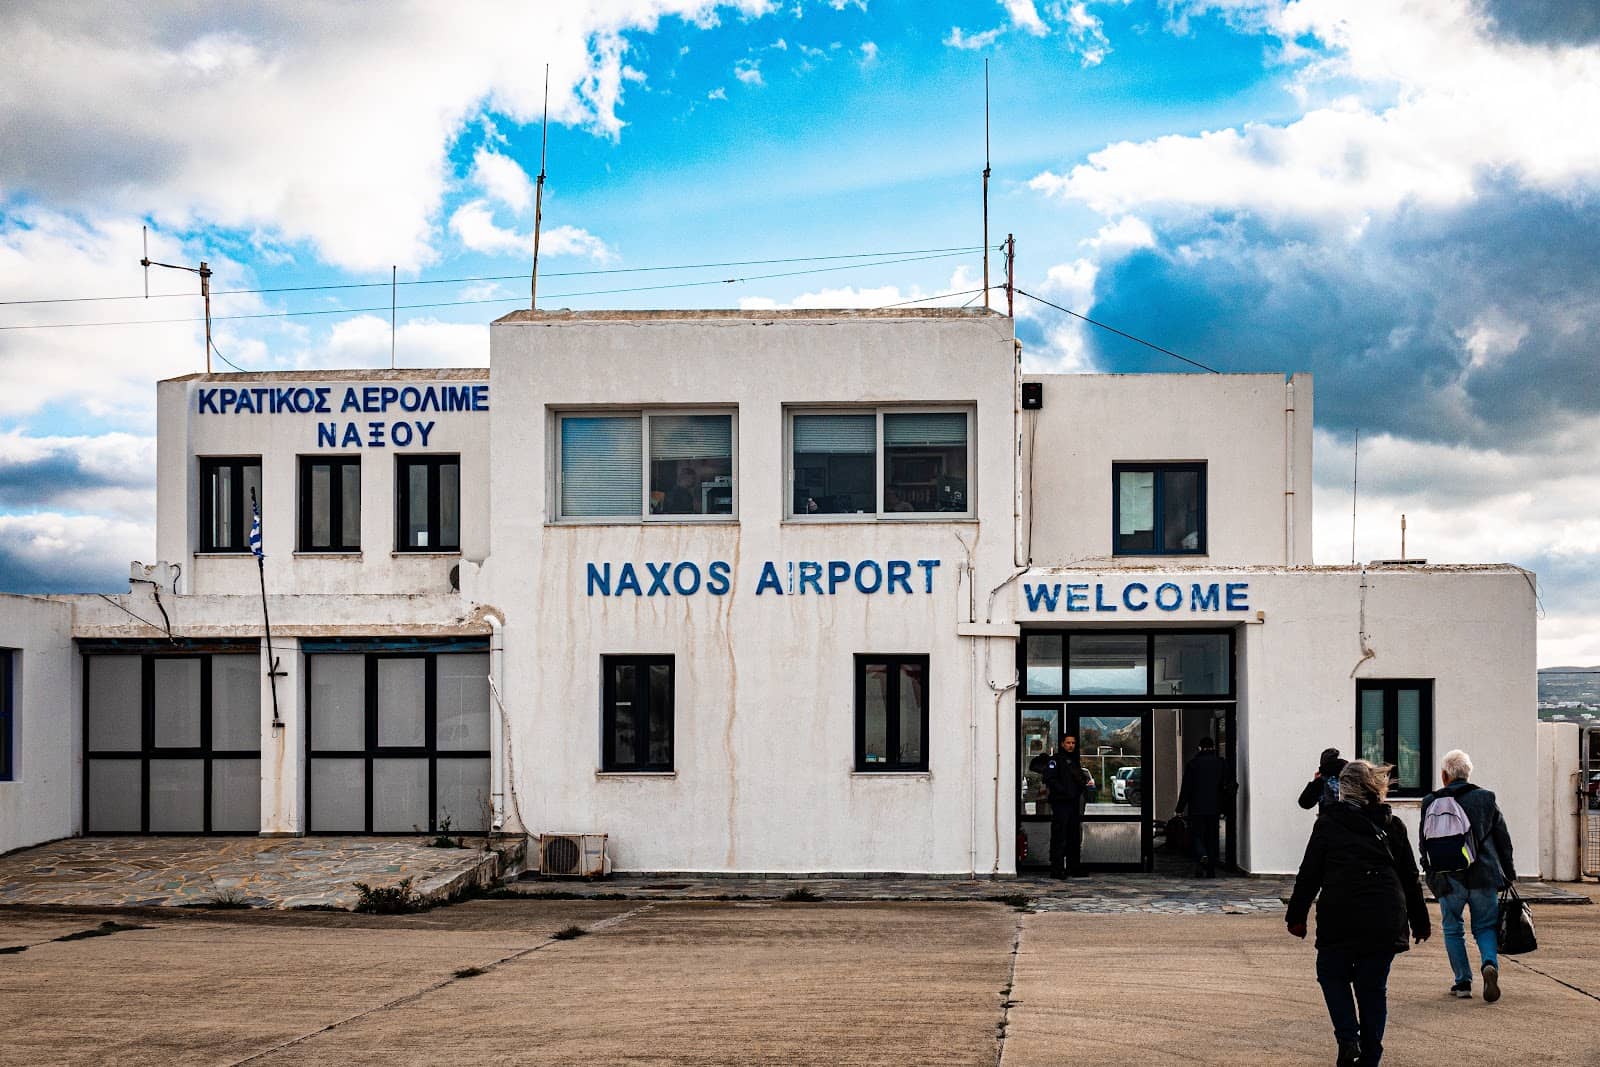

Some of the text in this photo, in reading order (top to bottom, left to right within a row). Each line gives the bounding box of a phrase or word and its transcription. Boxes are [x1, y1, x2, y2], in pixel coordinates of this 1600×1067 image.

[198, 387, 331, 414] ΚΡΑΤΙΚΟΣ
[318, 421, 435, 447] ΝΑΞΟΥ
[586, 559, 940, 596] NAXOS AIRPORT
[1024, 582, 1249, 612] WELCOME
